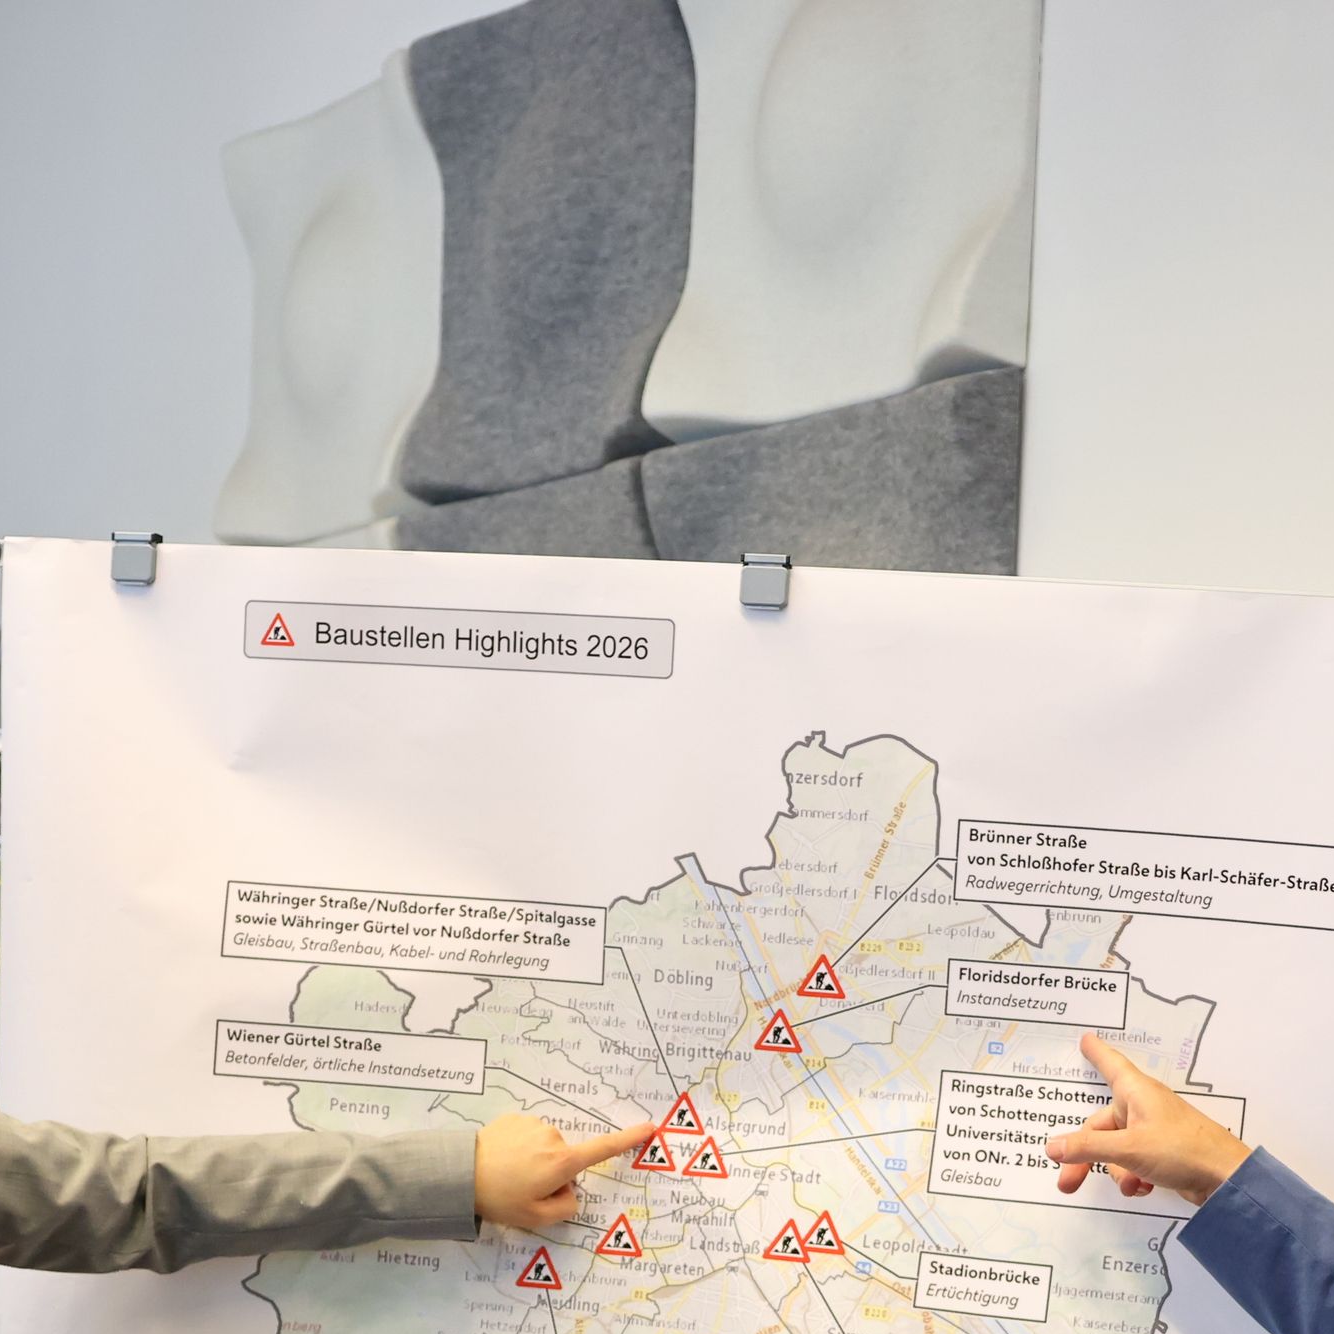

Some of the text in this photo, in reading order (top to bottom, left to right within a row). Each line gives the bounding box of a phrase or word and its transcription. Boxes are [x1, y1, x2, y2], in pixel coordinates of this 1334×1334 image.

[315, 622, 649, 659] Baustellen Highlights 2026
[785, 771, 863, 787] nzersdorf
[795, 808, 868, 821] ammersdorf
[969, 829, 1087, 849] Brünner Straße
[968, 854, 995, 867] von
[1000, 854, 1094, 873] Schloßhofer
[1099, 861, 1150, 877] Straße
[1154, 864, 1176, 879] bis
[966, 875, 1212, 908] Radwegerrichtung, Umgestaltung
[238, 889, 596, 928] Währinger Straße/Nußdorfer Straße/Spitalgasse
[235, 912, 570, 947] sowie Währinger Gürtel vor Nußdorfer Straße
[233, 933, 549, 971] Gleisbau, Straßenbau, Kabel- und Rohrlegung
[654, 969, 713, 990] Döbling
[959, 968, 1117, 993] Floridsdorfer Brücke
[956, 990, 1067, 1014] Instandsetzung
[227, 1029, 382, 1052] Wiener Gürtel Straße
[1097, 1029, 1161, 1046] Breitenlee
[666, 1042, 752, 1061] Brigittenau
[225, 1051, 474, 1083] Betonfelder, örtliche Instandsetzung
[1012, 1062, 1098, 1080] Hirschstetten
[541, 1078, 598, 1095] Hernals
[951, 1080, 1113, 1106] Ringstraße Schottenr
[330, 1097, 390, 1119] Penzing
[949, 1105, 976, 1117] von
[706, 1117, 786, 1136] Alsergrund
[946, 1125, 1048, 1146] Universitätsri
[888, 1160, 904, 1170] A22
[944, 1150, 970, 1161] von
[975, 1150, 1010, 1165] ONr.
[1015, 1154, 1023, 1166] 2
[1027, 1156, 1048, 1169] bis
[941, 1169, 1002, 1188] Gleisbau
[377, 1250, 440, 1271] Hietzing
[620, 1257, 704, 1276] Margareten
[929, 1260, 1040, 1285] Stadionbrücke
[926, 1283, 1019, 1309] Ertüchtigung
[1073, 1316, 1150, 1334] Kaiserebers
